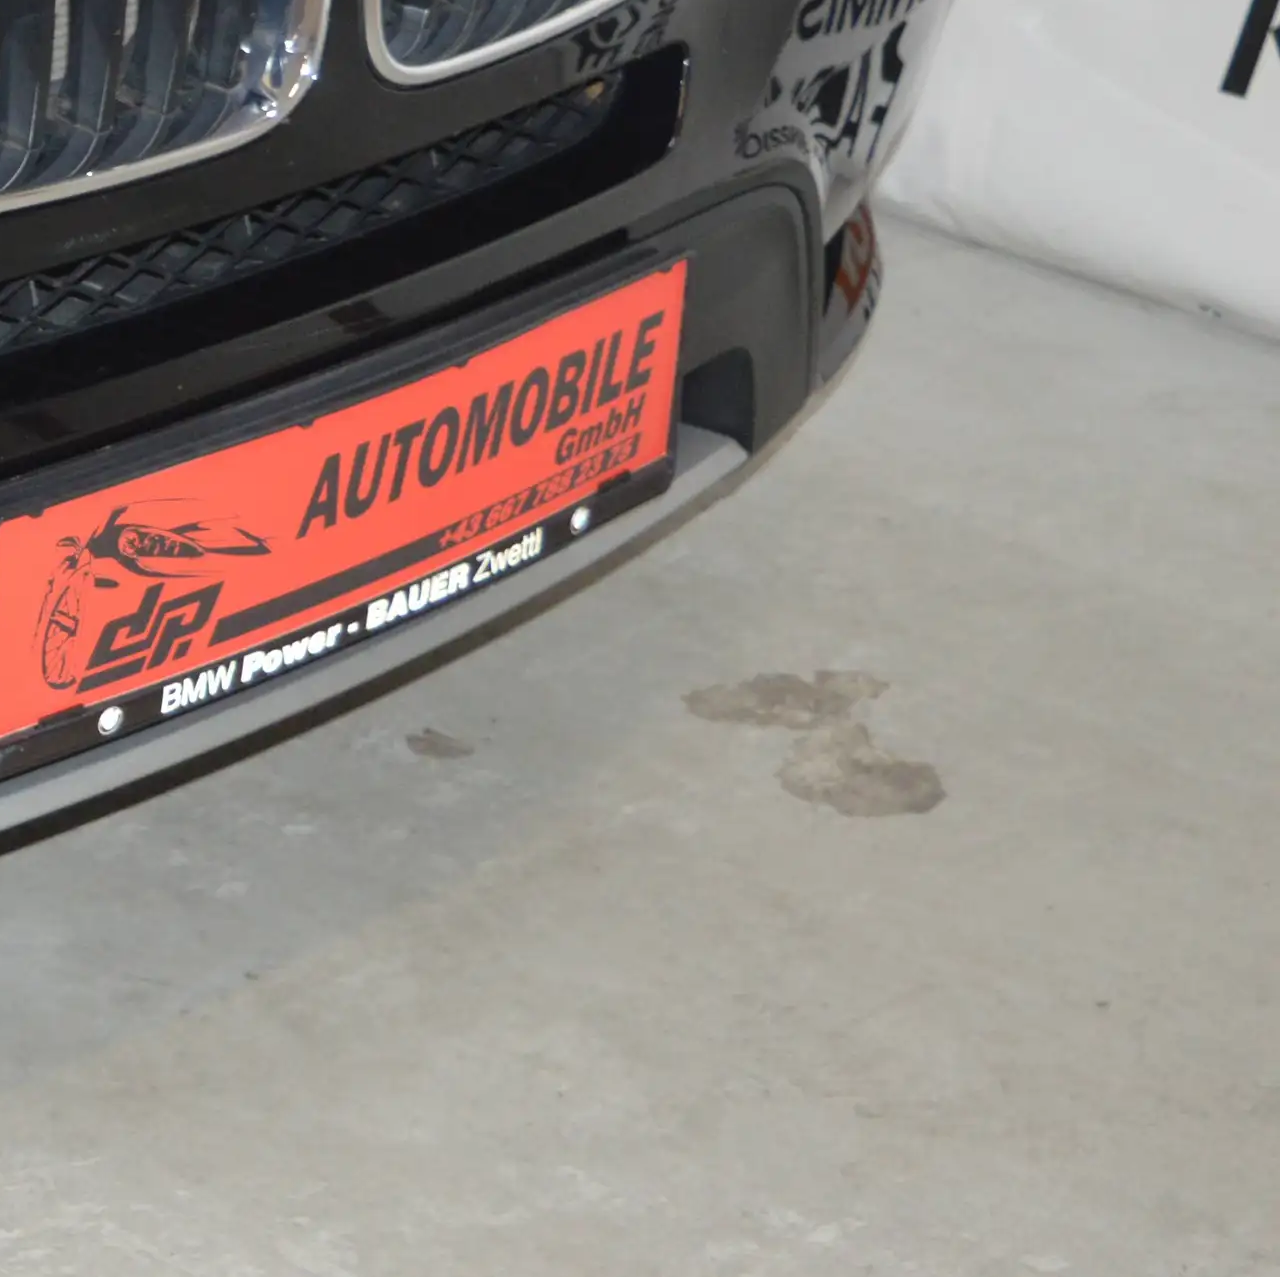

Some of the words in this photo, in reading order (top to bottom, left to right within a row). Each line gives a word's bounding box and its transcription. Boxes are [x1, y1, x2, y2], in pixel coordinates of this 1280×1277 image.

[295, 310, 664, 540] AUTOMOBILE
[555, 392, 646, 466] GmbH
[160, 659, 239, 715] BMW
[240, 623, 343, 684] Power
[365, 562, 470, 630] BAUER
[473, 527, 545, 582] Zwettl
